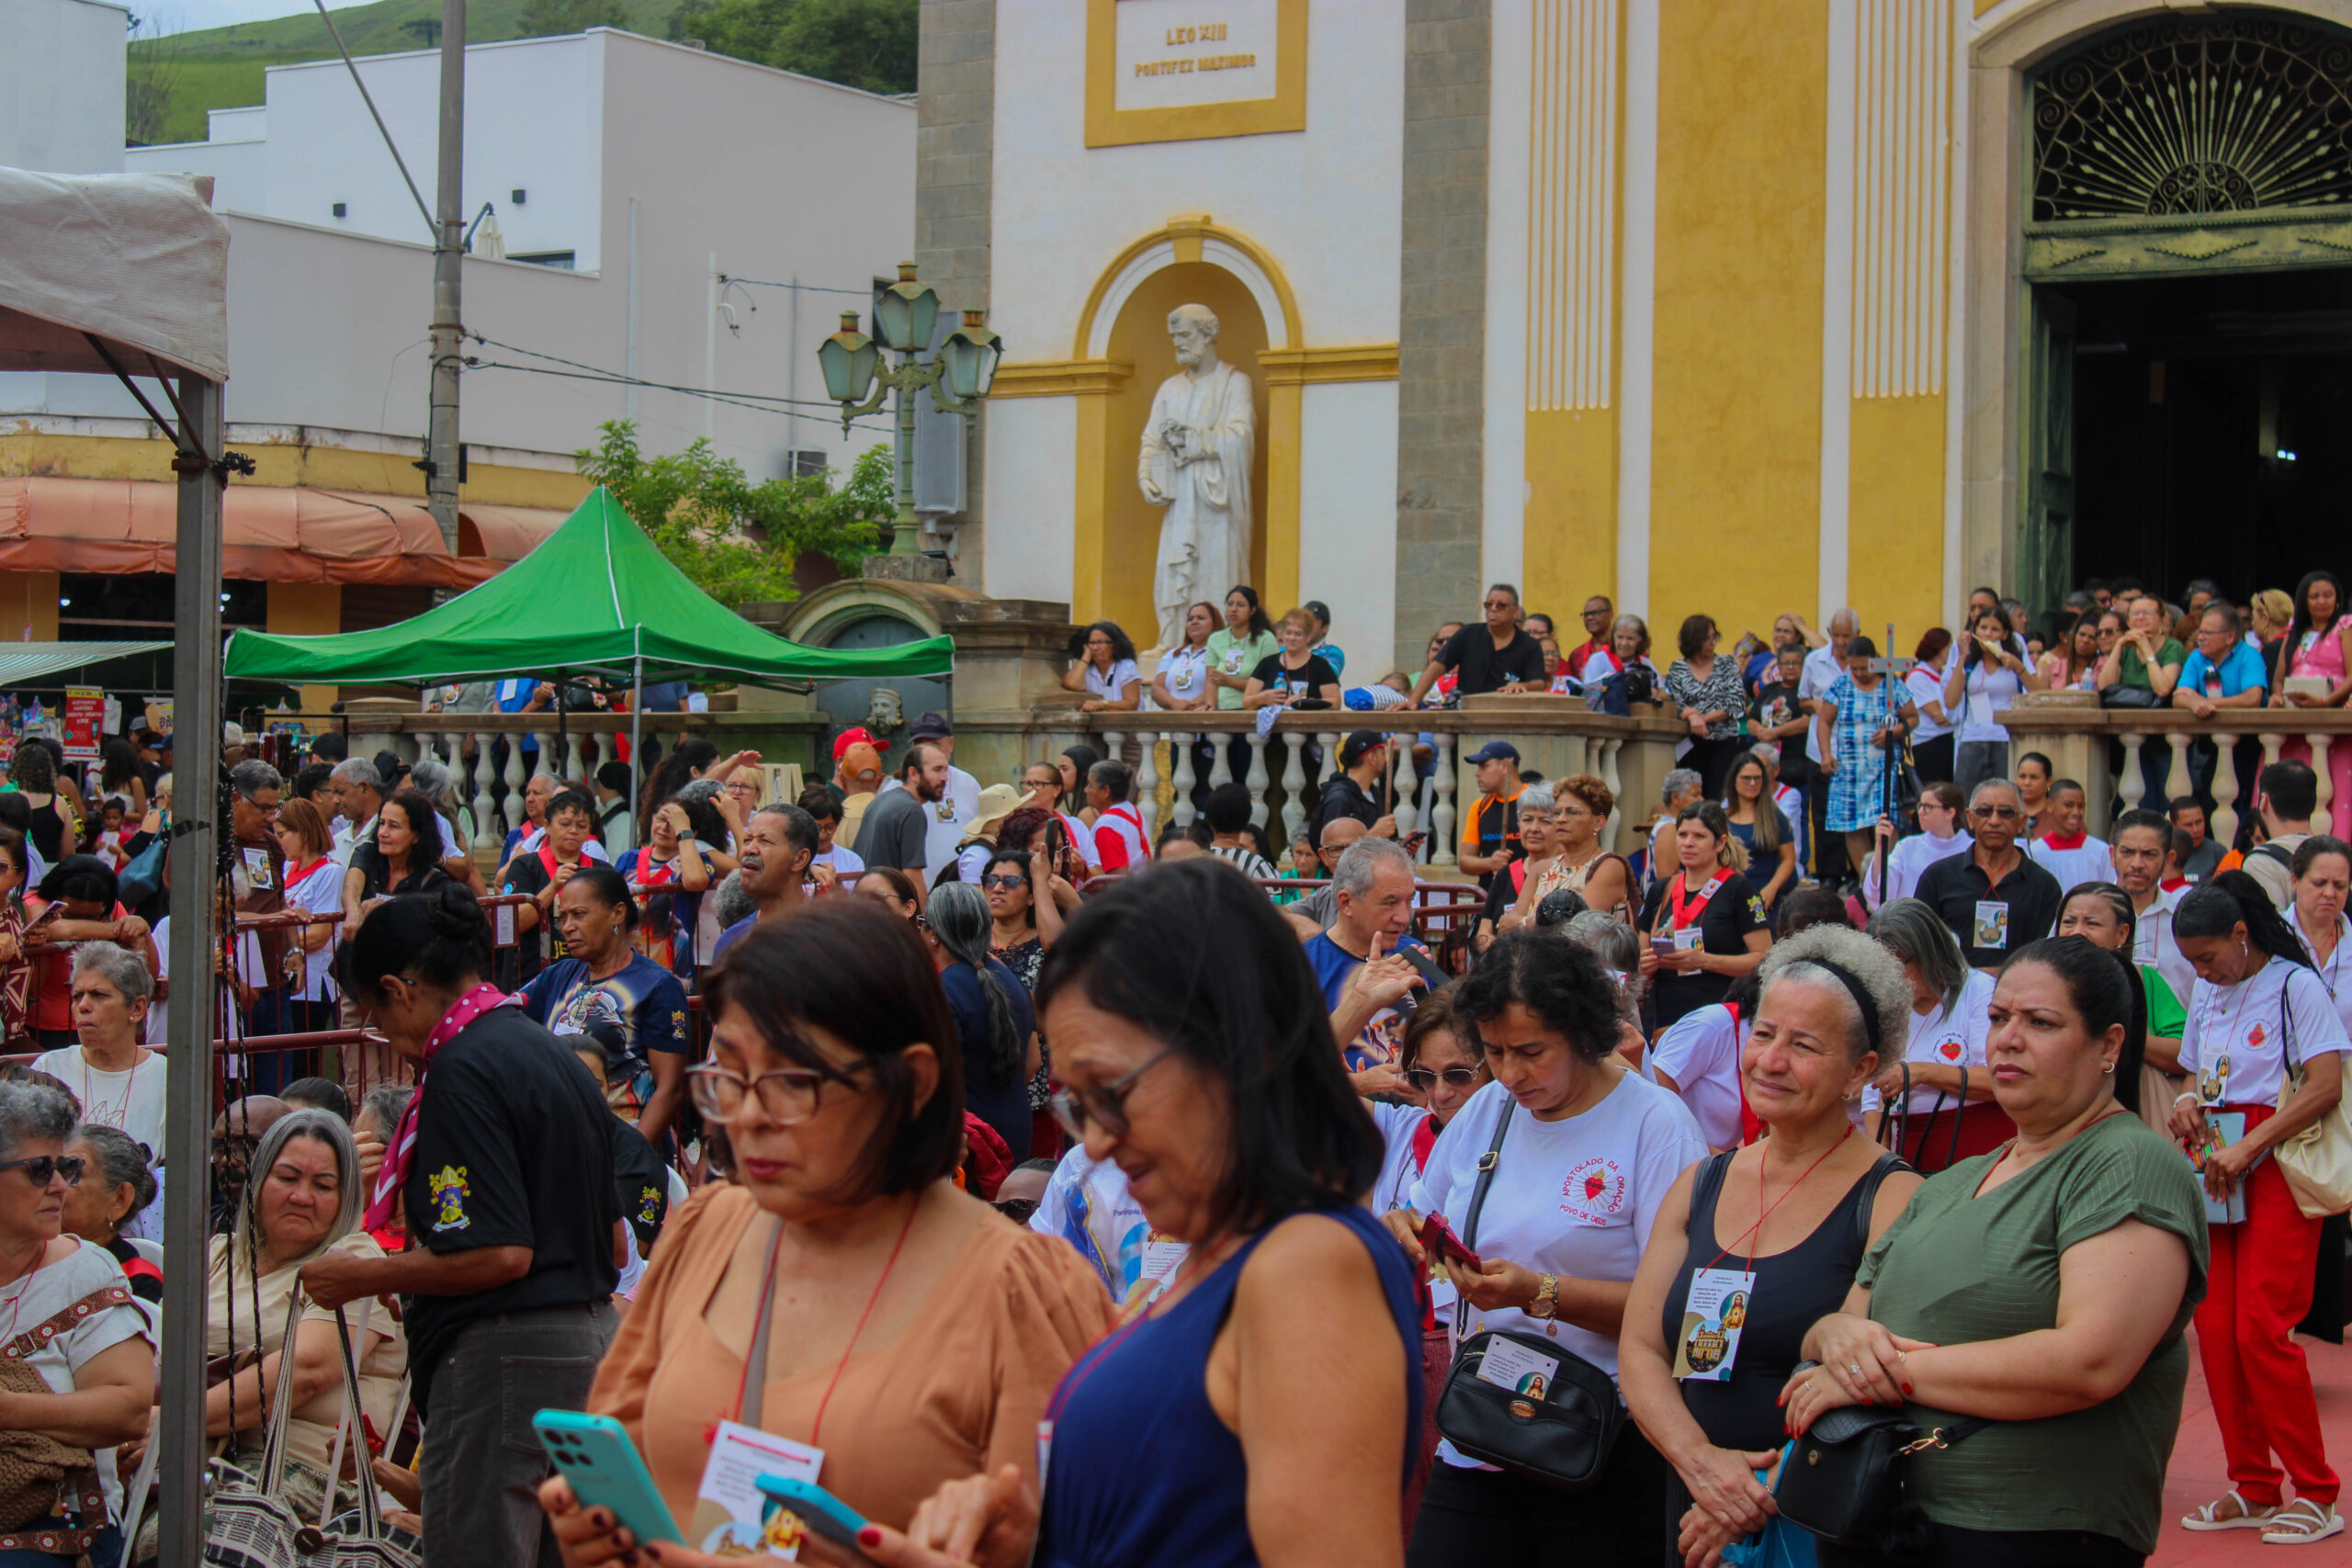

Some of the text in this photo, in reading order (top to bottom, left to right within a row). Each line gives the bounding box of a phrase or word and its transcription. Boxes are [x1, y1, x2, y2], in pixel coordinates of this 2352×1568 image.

[1166, 23, 1227, 45] LEO XIII
[1135, 53, 1256, 77] PONTIFEX MAXIMUS
[1562, 1157, 1625, 1213] APOSTOLADO DA ORAÇÃO
[1559, 1204, 1607, 1227] POVO DE DEUS
